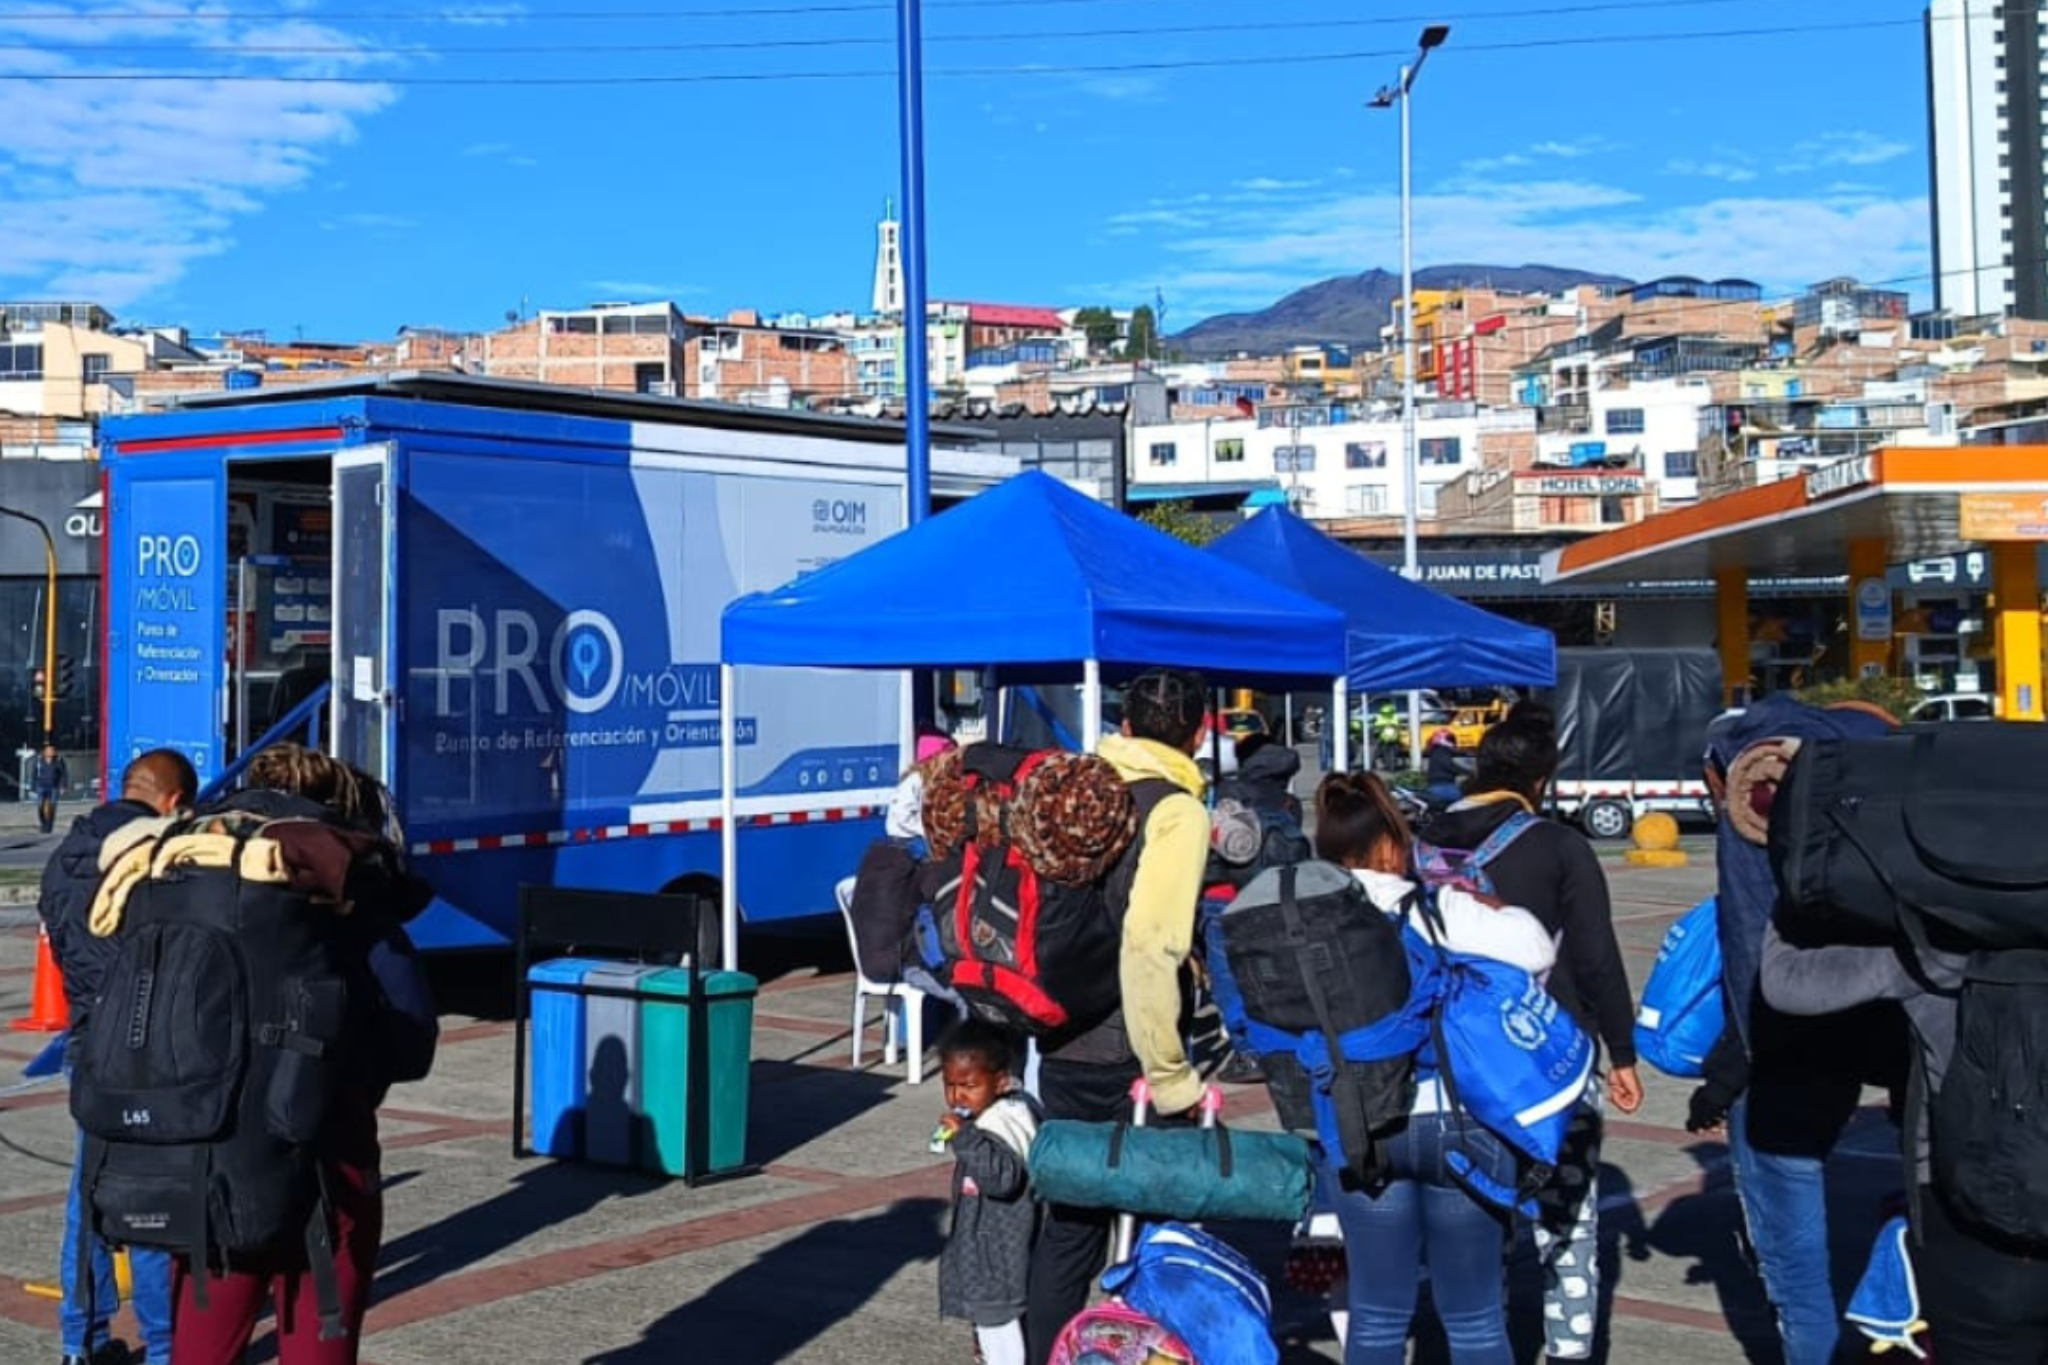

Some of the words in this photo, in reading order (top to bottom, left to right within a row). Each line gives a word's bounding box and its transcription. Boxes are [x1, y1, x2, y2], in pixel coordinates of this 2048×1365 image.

[1541, 476, 1593, 491] HOTEL
[832, 499, 866, 523] OIM
[139, 534, 200, 577] PRO
[1427, 564, 1471, 580] JUAN
[1475, 563, 1498, 580] DE
[1501, 563, 1541, 579] PAST
[436, 608, 624, 717] PRO
[497, 729, 521, 751] de
[651, 729, 661, 748] y
